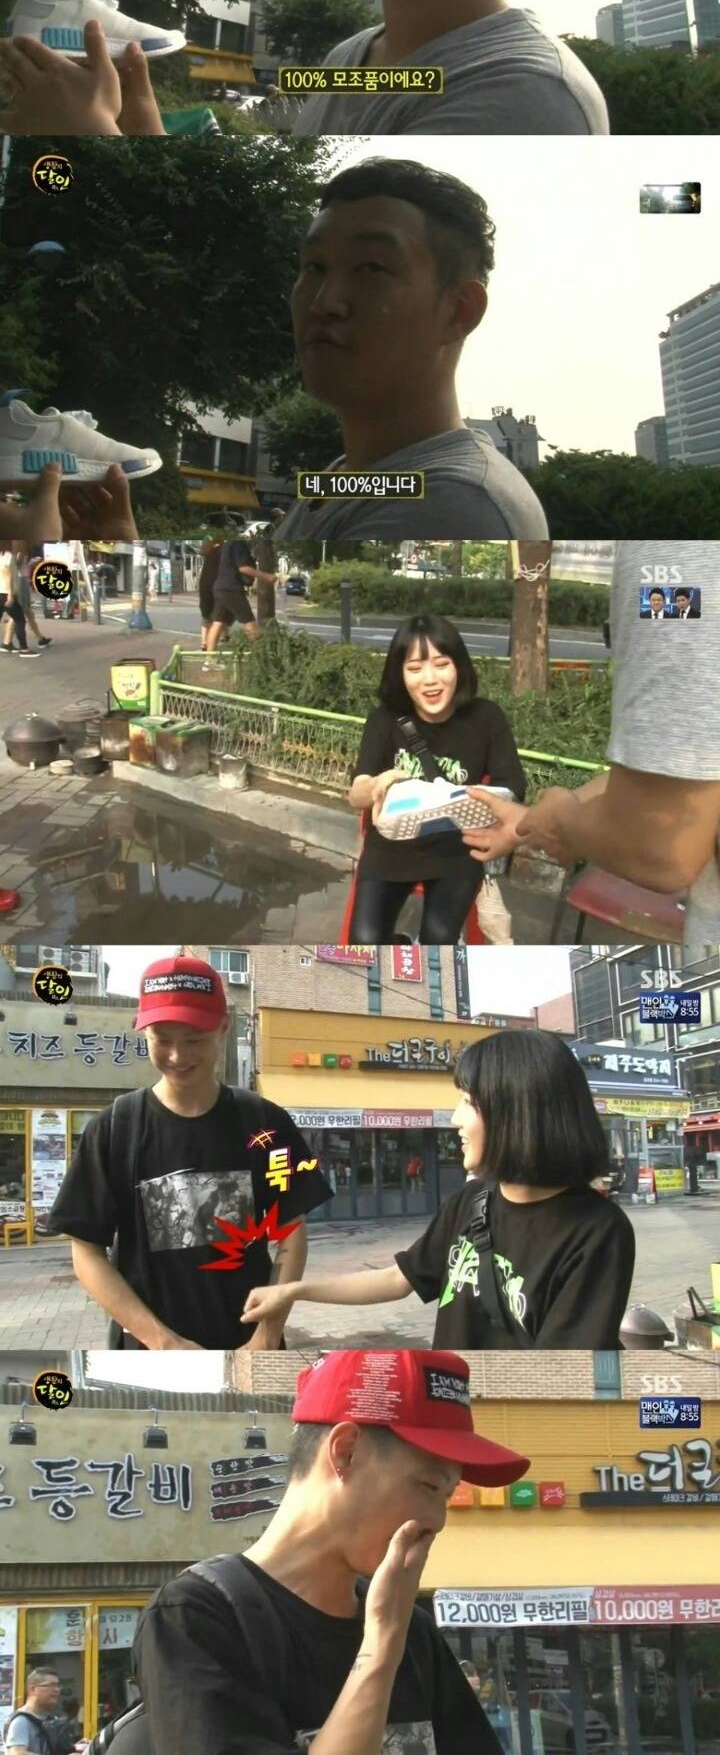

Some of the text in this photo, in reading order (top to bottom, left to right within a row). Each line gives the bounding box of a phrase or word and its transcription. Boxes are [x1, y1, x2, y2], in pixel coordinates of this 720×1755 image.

[8, 1031, 64, 1059] 치즈
[366, 1048, 391, 1063] The
[328, 1114, 361, 1127] 무한리필
[404, 1115, 433, 1127] 무한리필
[30, 1453, 193, 1522] 등갈비
[594, 1466, 646, 1492] The
[437, 1601, 588, 1623] 12,000원 무한리필
[594, 1599, 674, 1622] 10,000원
